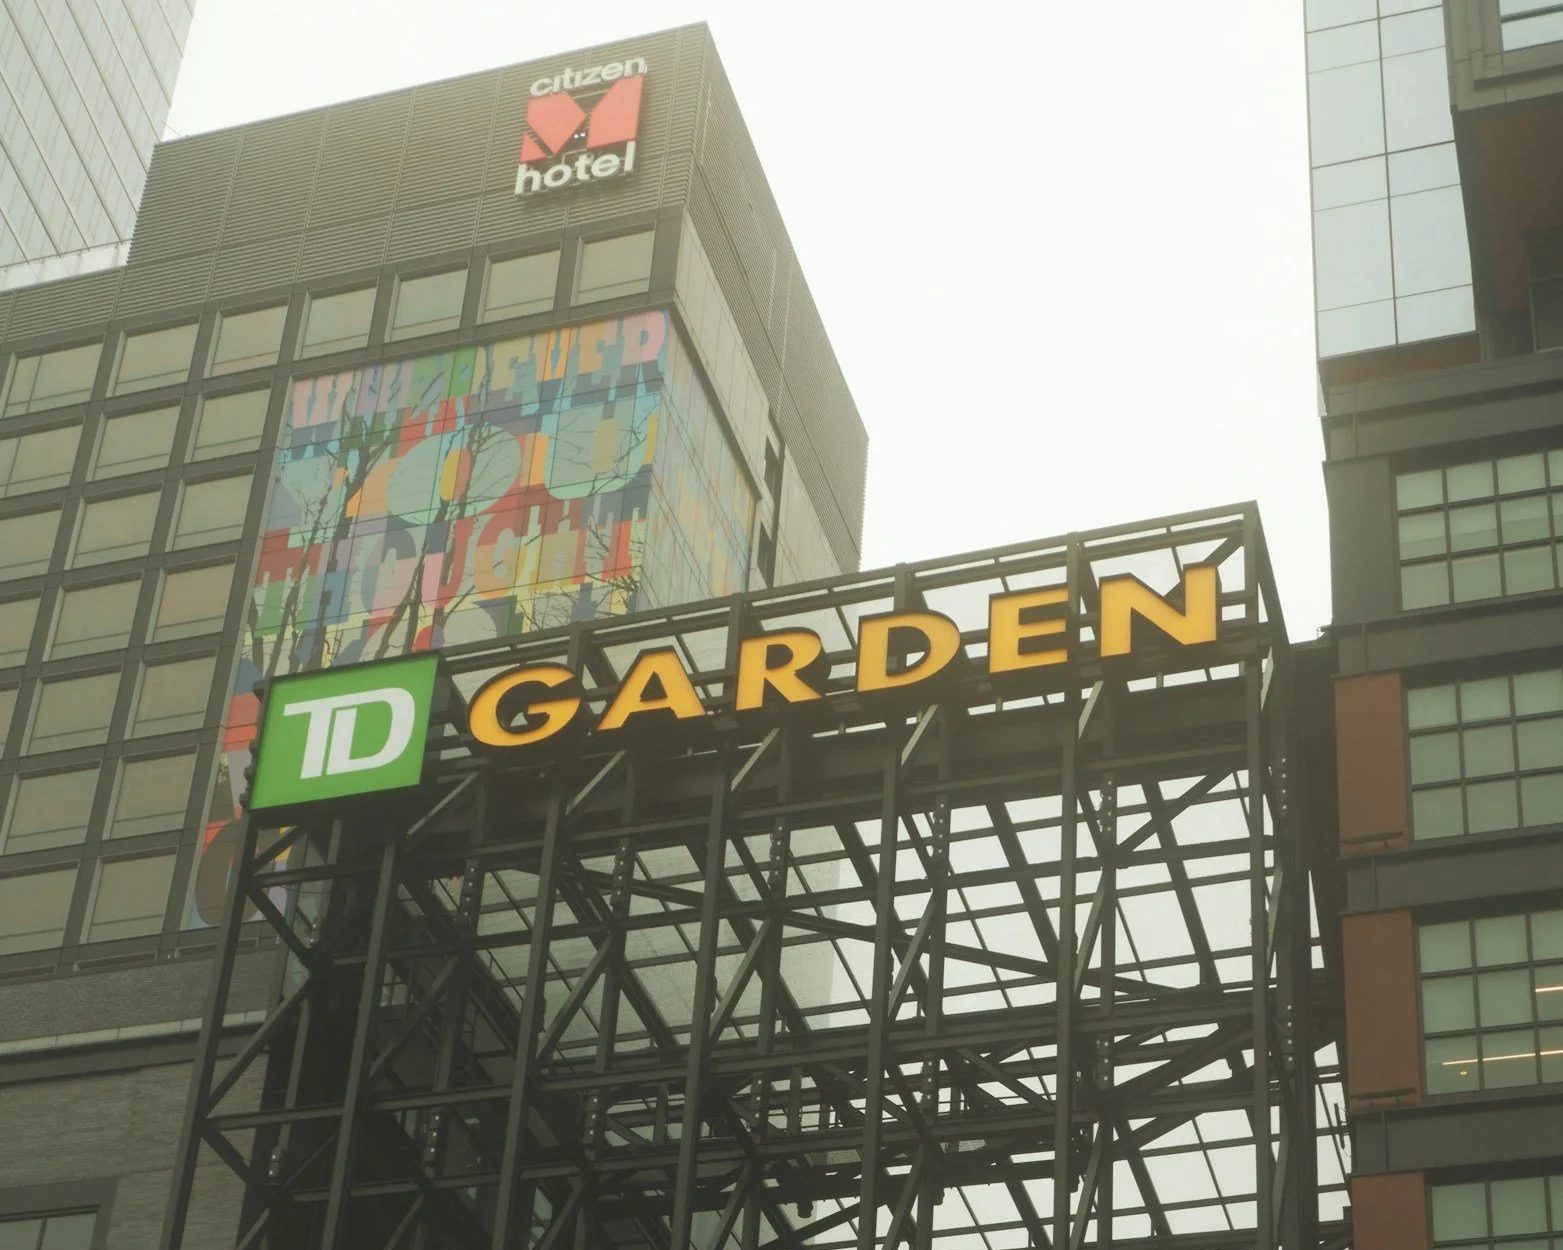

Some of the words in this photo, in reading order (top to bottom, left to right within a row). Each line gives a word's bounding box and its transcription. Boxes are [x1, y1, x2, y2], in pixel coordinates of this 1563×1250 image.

[530, 57, 647, 96] citizen
[514, 140, 636, 195] hotel
[283, 687, 416, 780] TD
[469, 566, 1222, 747] GARDEN
